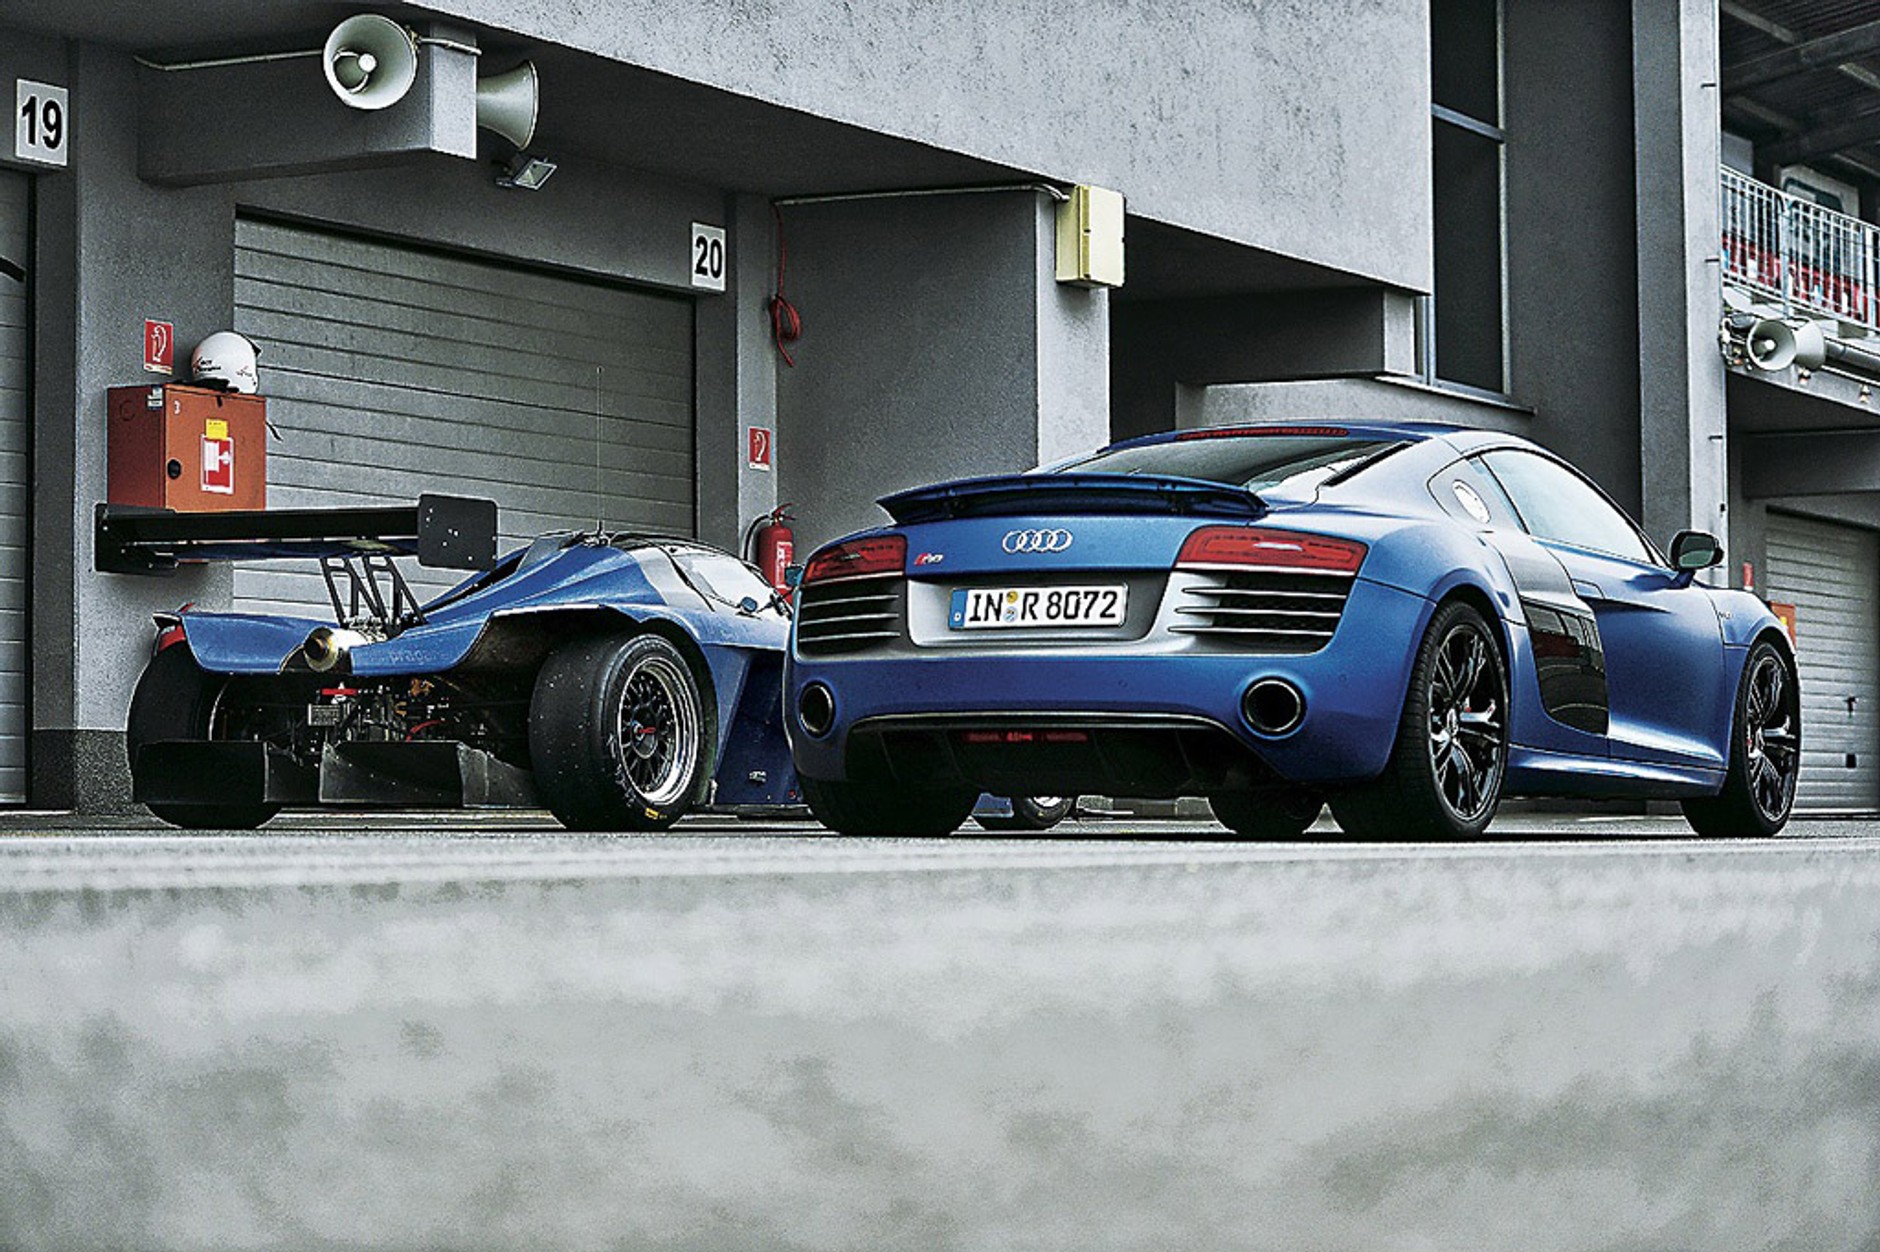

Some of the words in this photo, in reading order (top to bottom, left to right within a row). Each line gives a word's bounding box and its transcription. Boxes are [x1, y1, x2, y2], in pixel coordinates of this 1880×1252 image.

[22, 95, 62, 150] 19
[695, 235, 722, 279] 20
[969, 593, 1003, 622] IN
[1021, 592, 1039, 620] R
[1046, 590, 1118, 620] 8072
